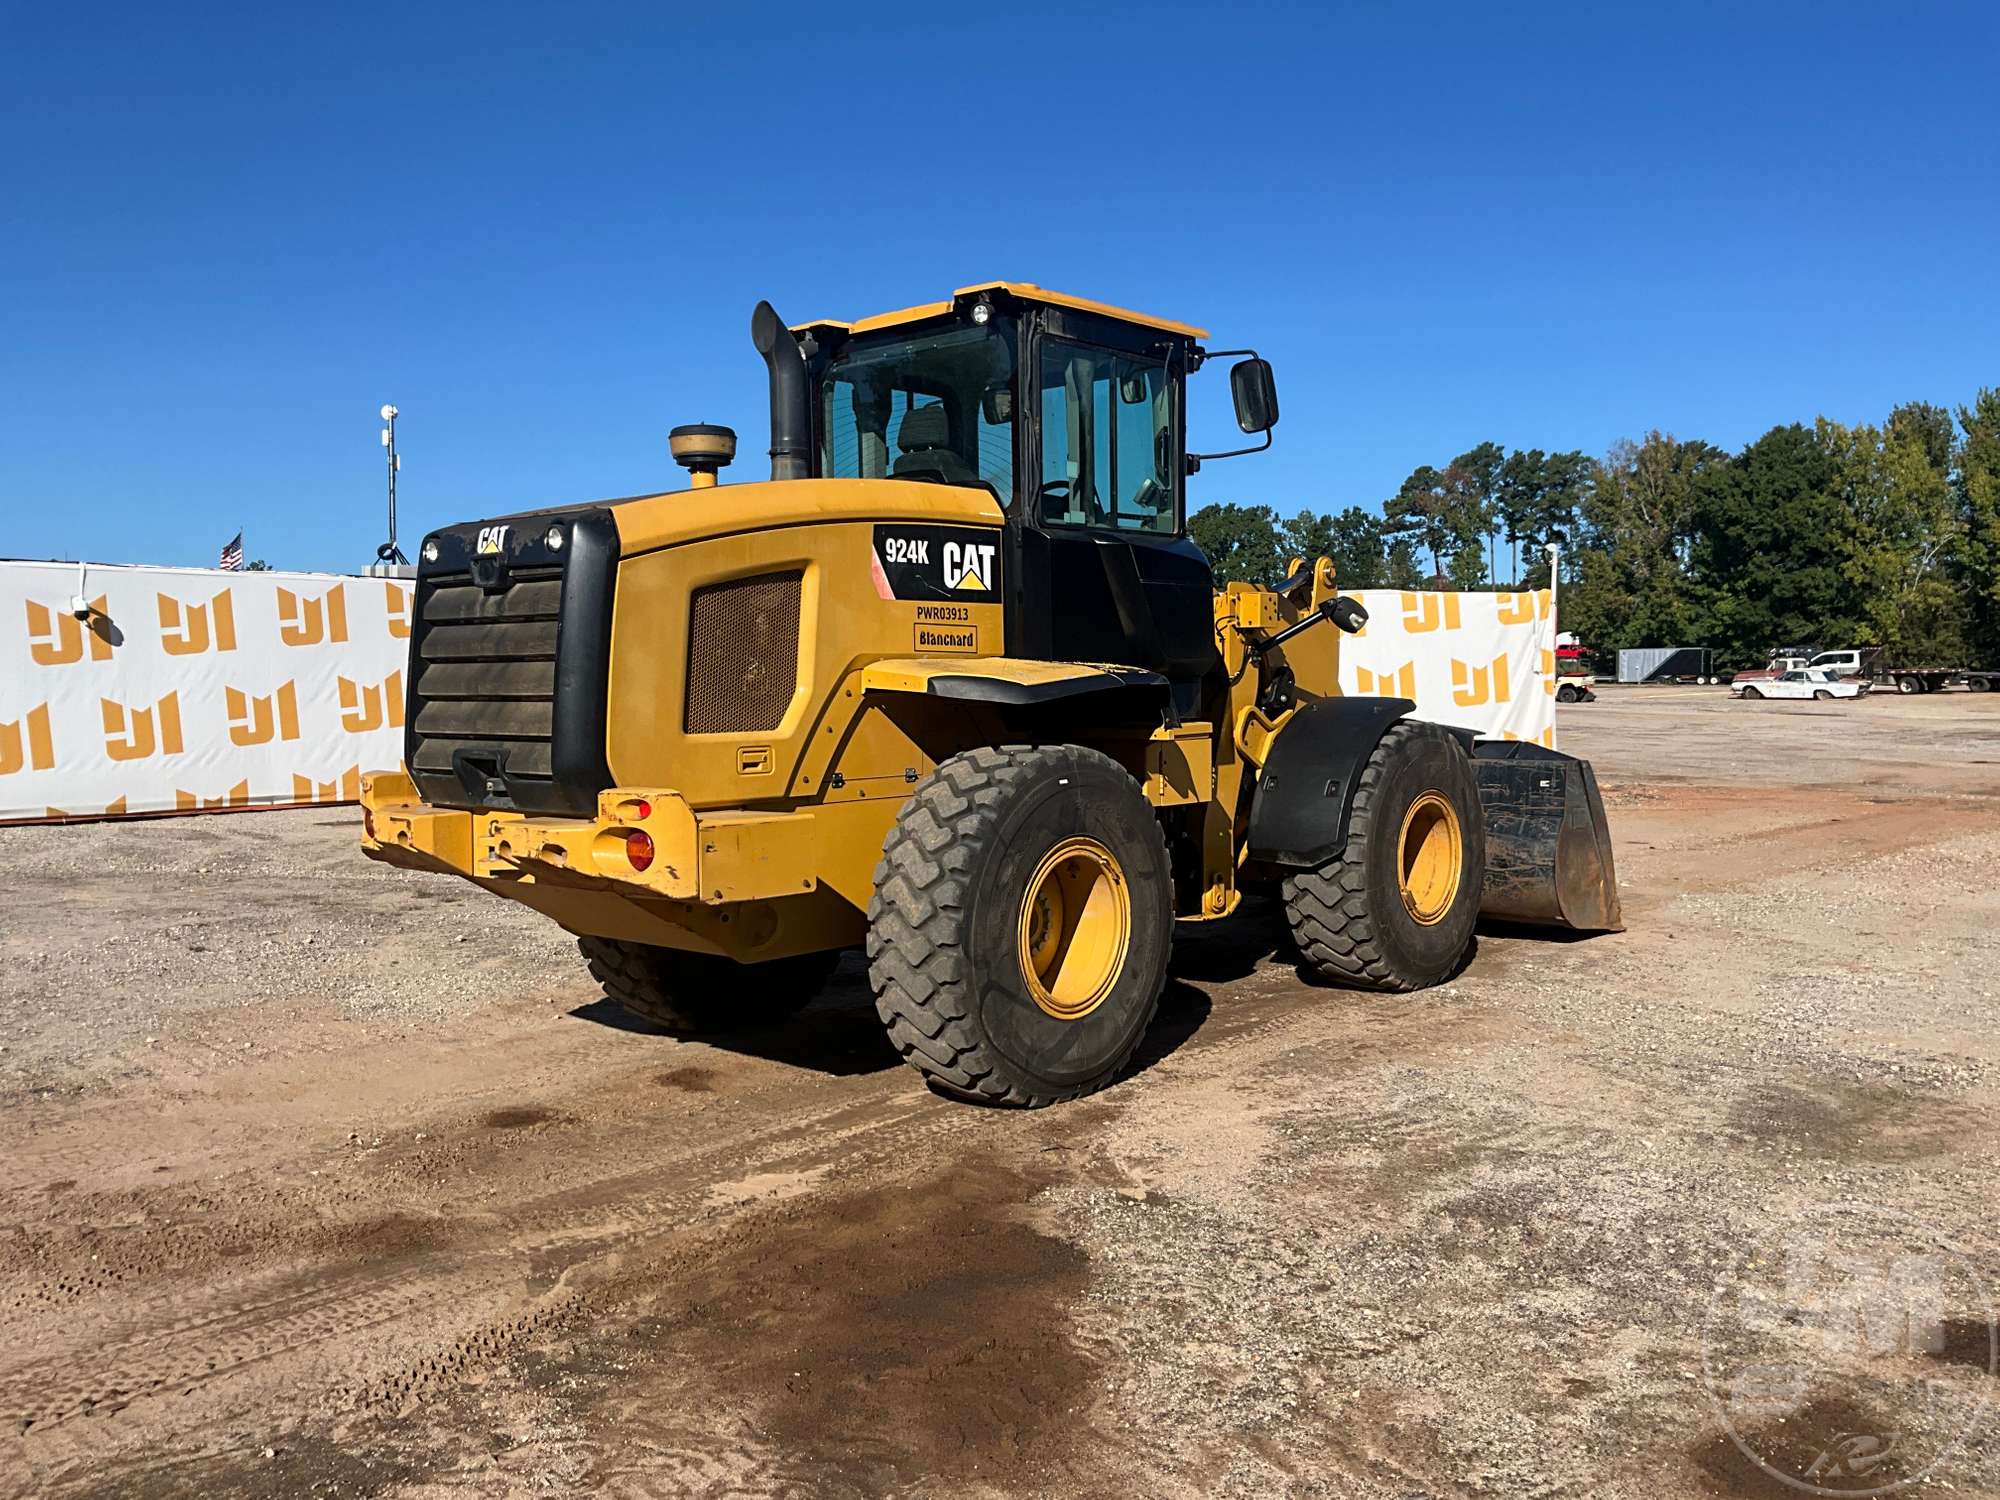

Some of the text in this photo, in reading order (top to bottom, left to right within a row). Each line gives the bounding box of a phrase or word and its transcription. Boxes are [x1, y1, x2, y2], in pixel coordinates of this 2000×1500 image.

[477, 525, 510, 554] CAT
[885, 537, 930, 565] 924K
[943, 541, 995, 591] CAT
[917, 606, 969, 621] PWR03913
